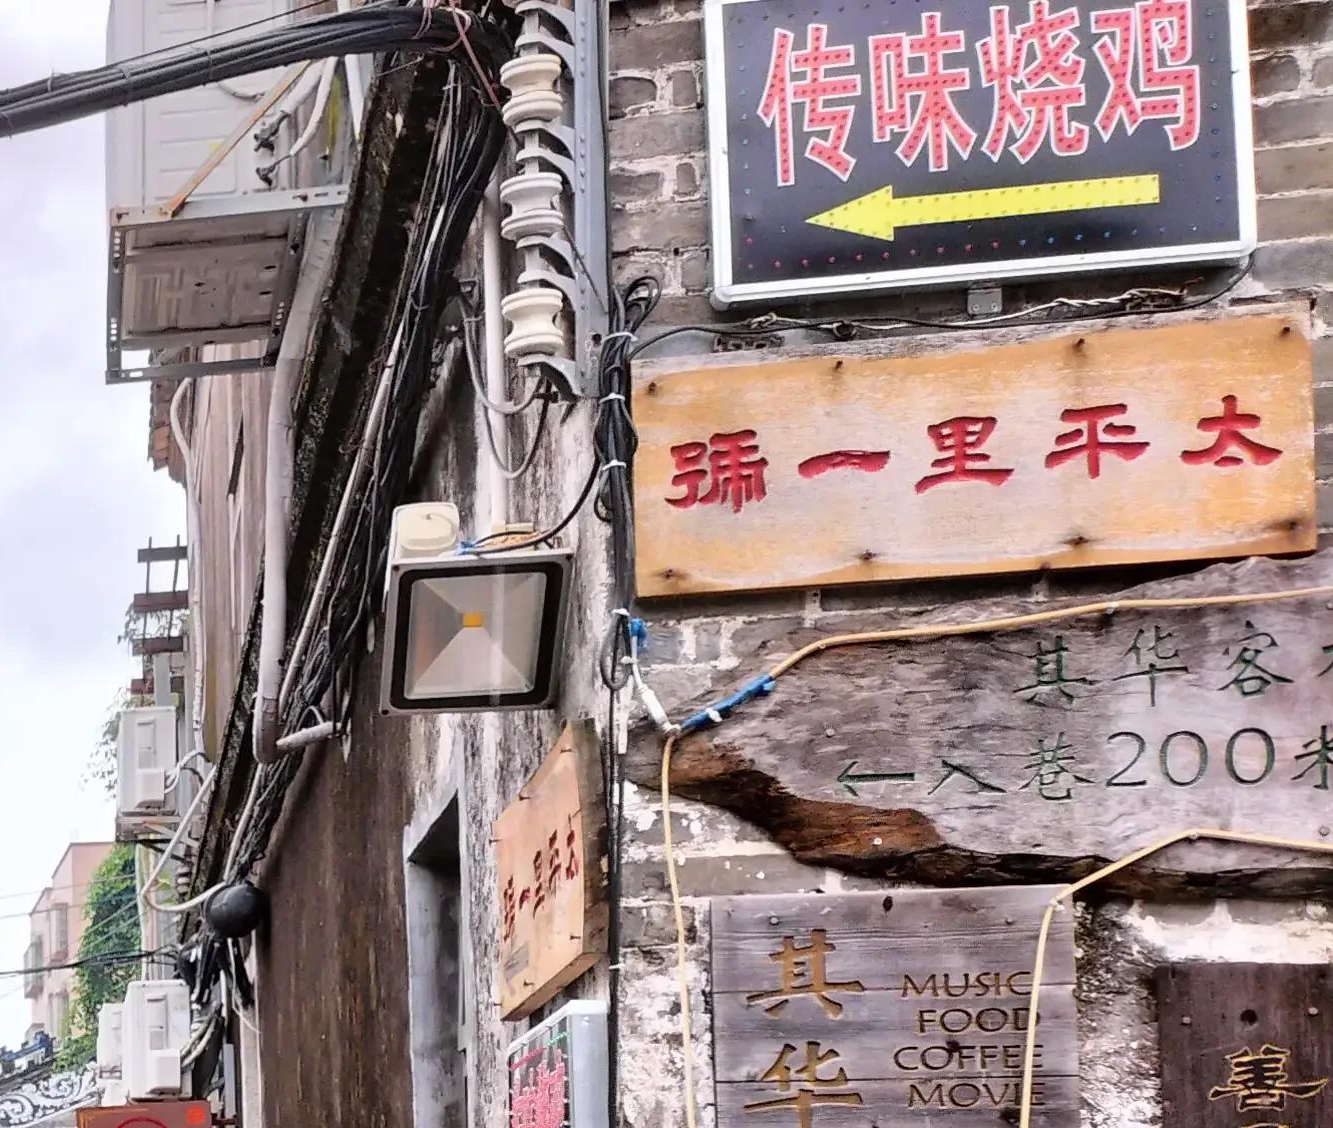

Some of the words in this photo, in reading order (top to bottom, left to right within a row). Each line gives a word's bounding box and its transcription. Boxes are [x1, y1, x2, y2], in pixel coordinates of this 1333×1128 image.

[757, 0, 1201, 187] 传味烧鸡
[1013, 620, 1333, 707] 其华客
[902, 971, 1033, 997] MUSIC
[919, 1007, 1041, 1033] FOOD
[894, 1044, 1044, 1070] COFFEE
[908, 1082, 1045, 1107] MOVIE
